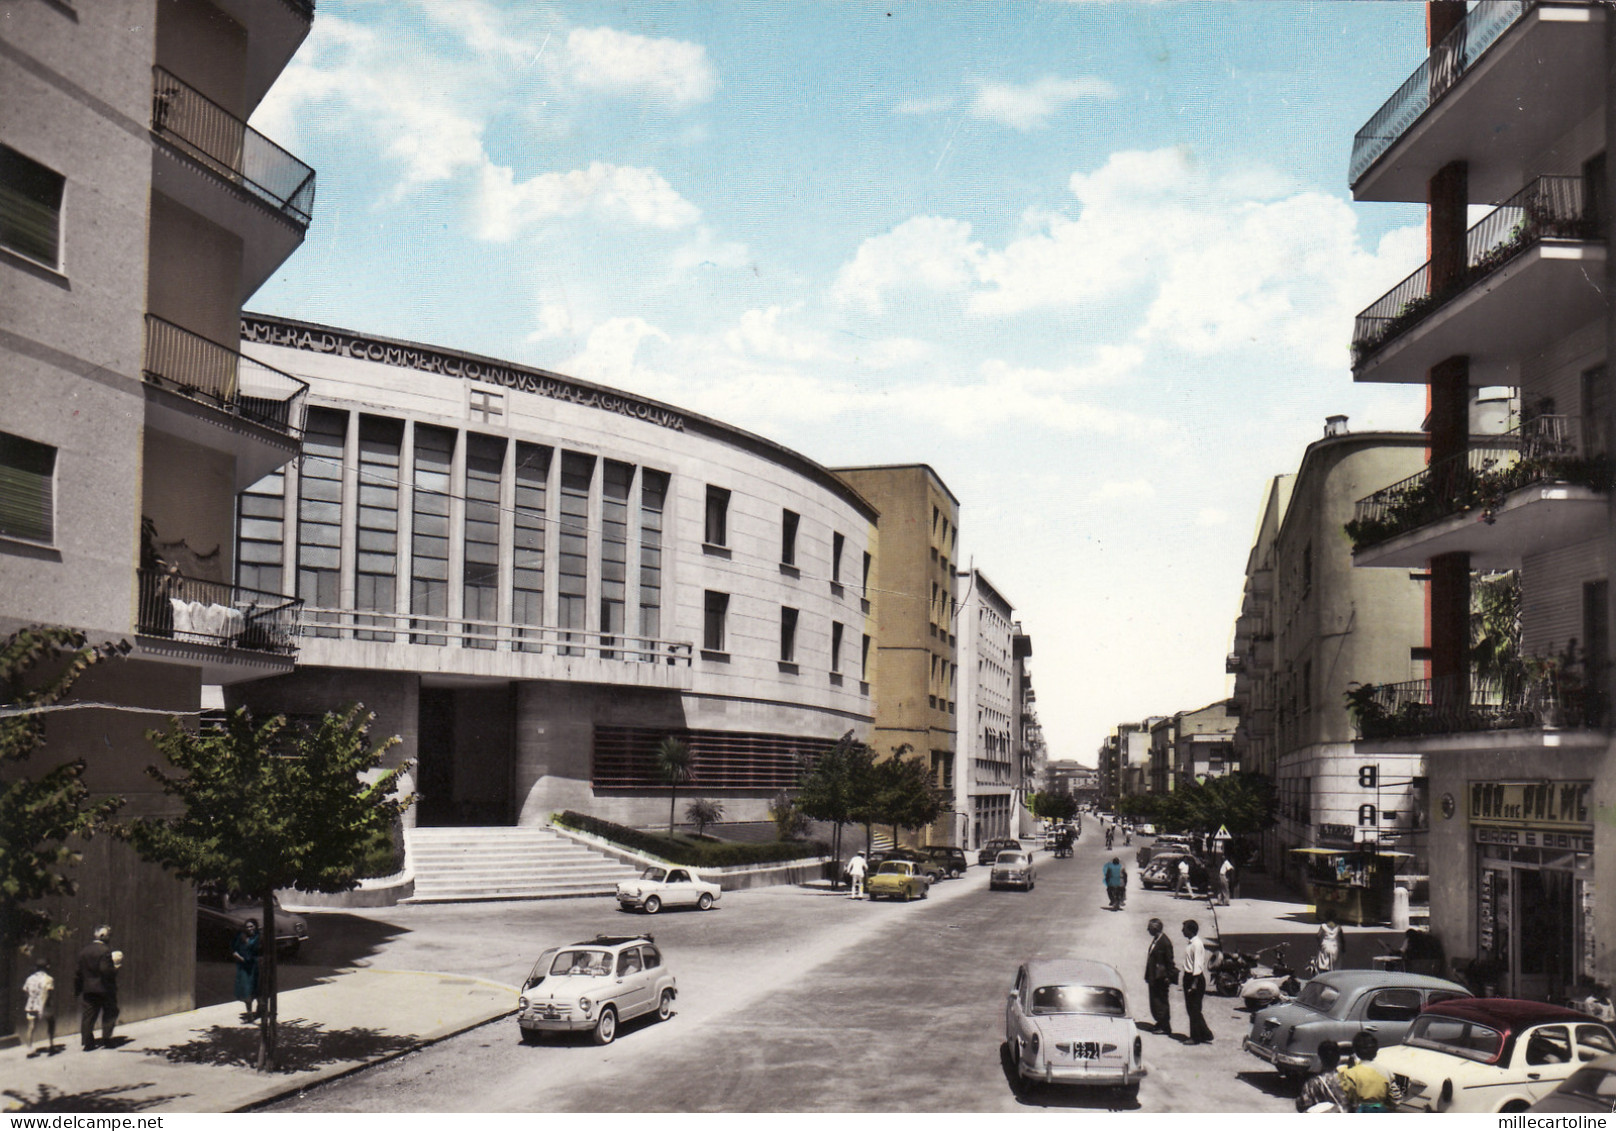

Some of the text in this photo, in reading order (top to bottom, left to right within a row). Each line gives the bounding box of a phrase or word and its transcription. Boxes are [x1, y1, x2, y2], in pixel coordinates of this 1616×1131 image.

[240, 320, 314, 350] AMERA
[321, 334, 343, 354] DI
[349, 340, 481, 378] COMMERCIO
